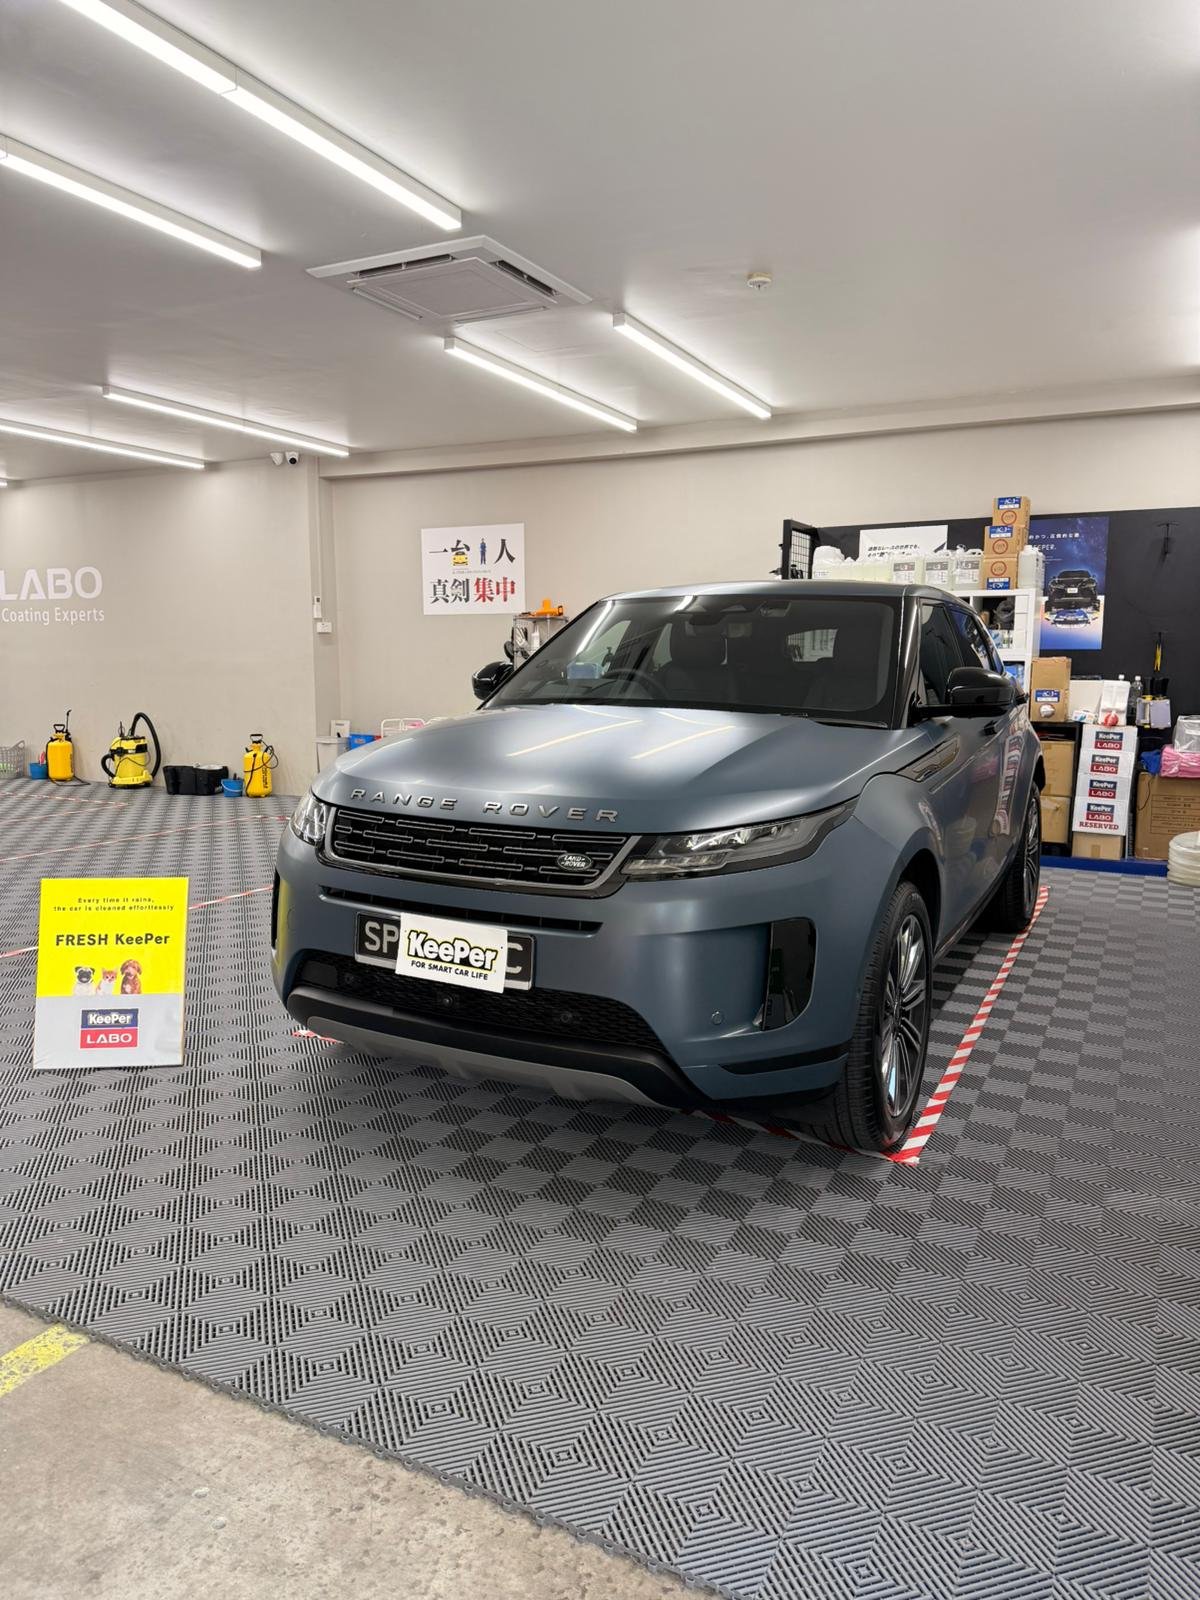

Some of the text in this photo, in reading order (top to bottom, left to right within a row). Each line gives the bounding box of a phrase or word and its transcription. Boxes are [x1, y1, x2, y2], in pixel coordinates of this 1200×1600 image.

[0, 566, 103, 600] LABO
[1, 607, 105, 626] Coating Experts
[1093, 765, 1117, 773] LABO
[350, 788, 619, 823] RANGE ROVER
[1088, 813, 1112, 821] LABO
[1079, 821, 1119, 830] RESERVED
[129, 904, 174, 912] effortlessly
[55, 932, 170, 946] FRESH KeePer
[407, 929, 498, 972] KeePer
[410, 959, 489, 981] FOR SMART CAR LIFE
[88, 1012, 133, 1025] KeePer
[86, 1033, 133, 1044] LABO
